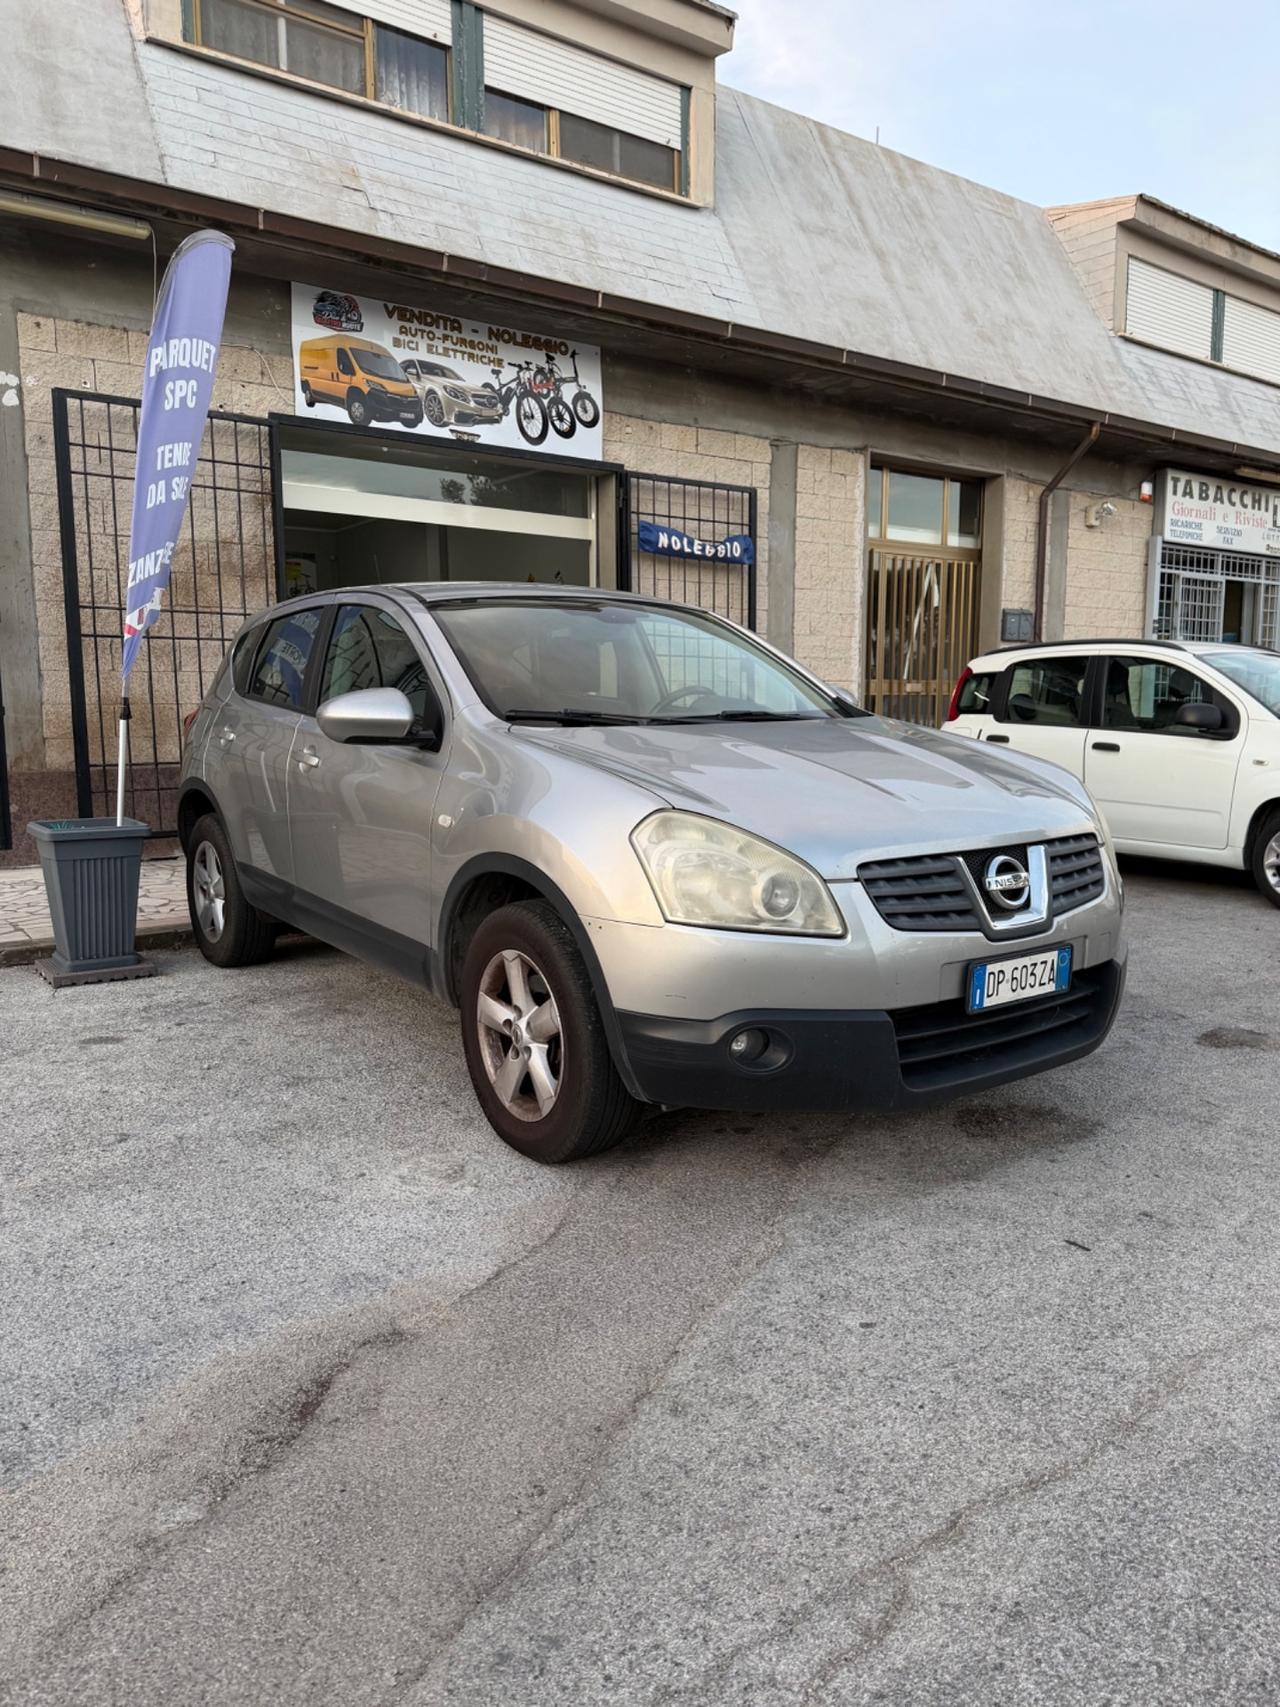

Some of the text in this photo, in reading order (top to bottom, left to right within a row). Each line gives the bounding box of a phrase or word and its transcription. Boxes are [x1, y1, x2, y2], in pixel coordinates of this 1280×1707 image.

[384, 303, 462, 334] VENDITA
[488, 326, 569, 356] NOLEGGIO
[399, 325, 498, 355] AUTO-FURGONI
[149, 338, 216, 377] PARQUET
[392, 336, 505, 369] BICI ELETTRICHE
[164, 379, 198, 410] SPC
[146, 479, 166, 510] DA
[1170, 476, 1269, 513] TABACCHI
[1170, 518, 1203, 532] RICARICHE
[1172, 500, 1268, 529] Giornali e Riviste
[658, 532, 741, 558] NOLEGGIO
[1222, 536, 1234, 546] FAX
[1011, 959, 1055, 993] 603ZA
